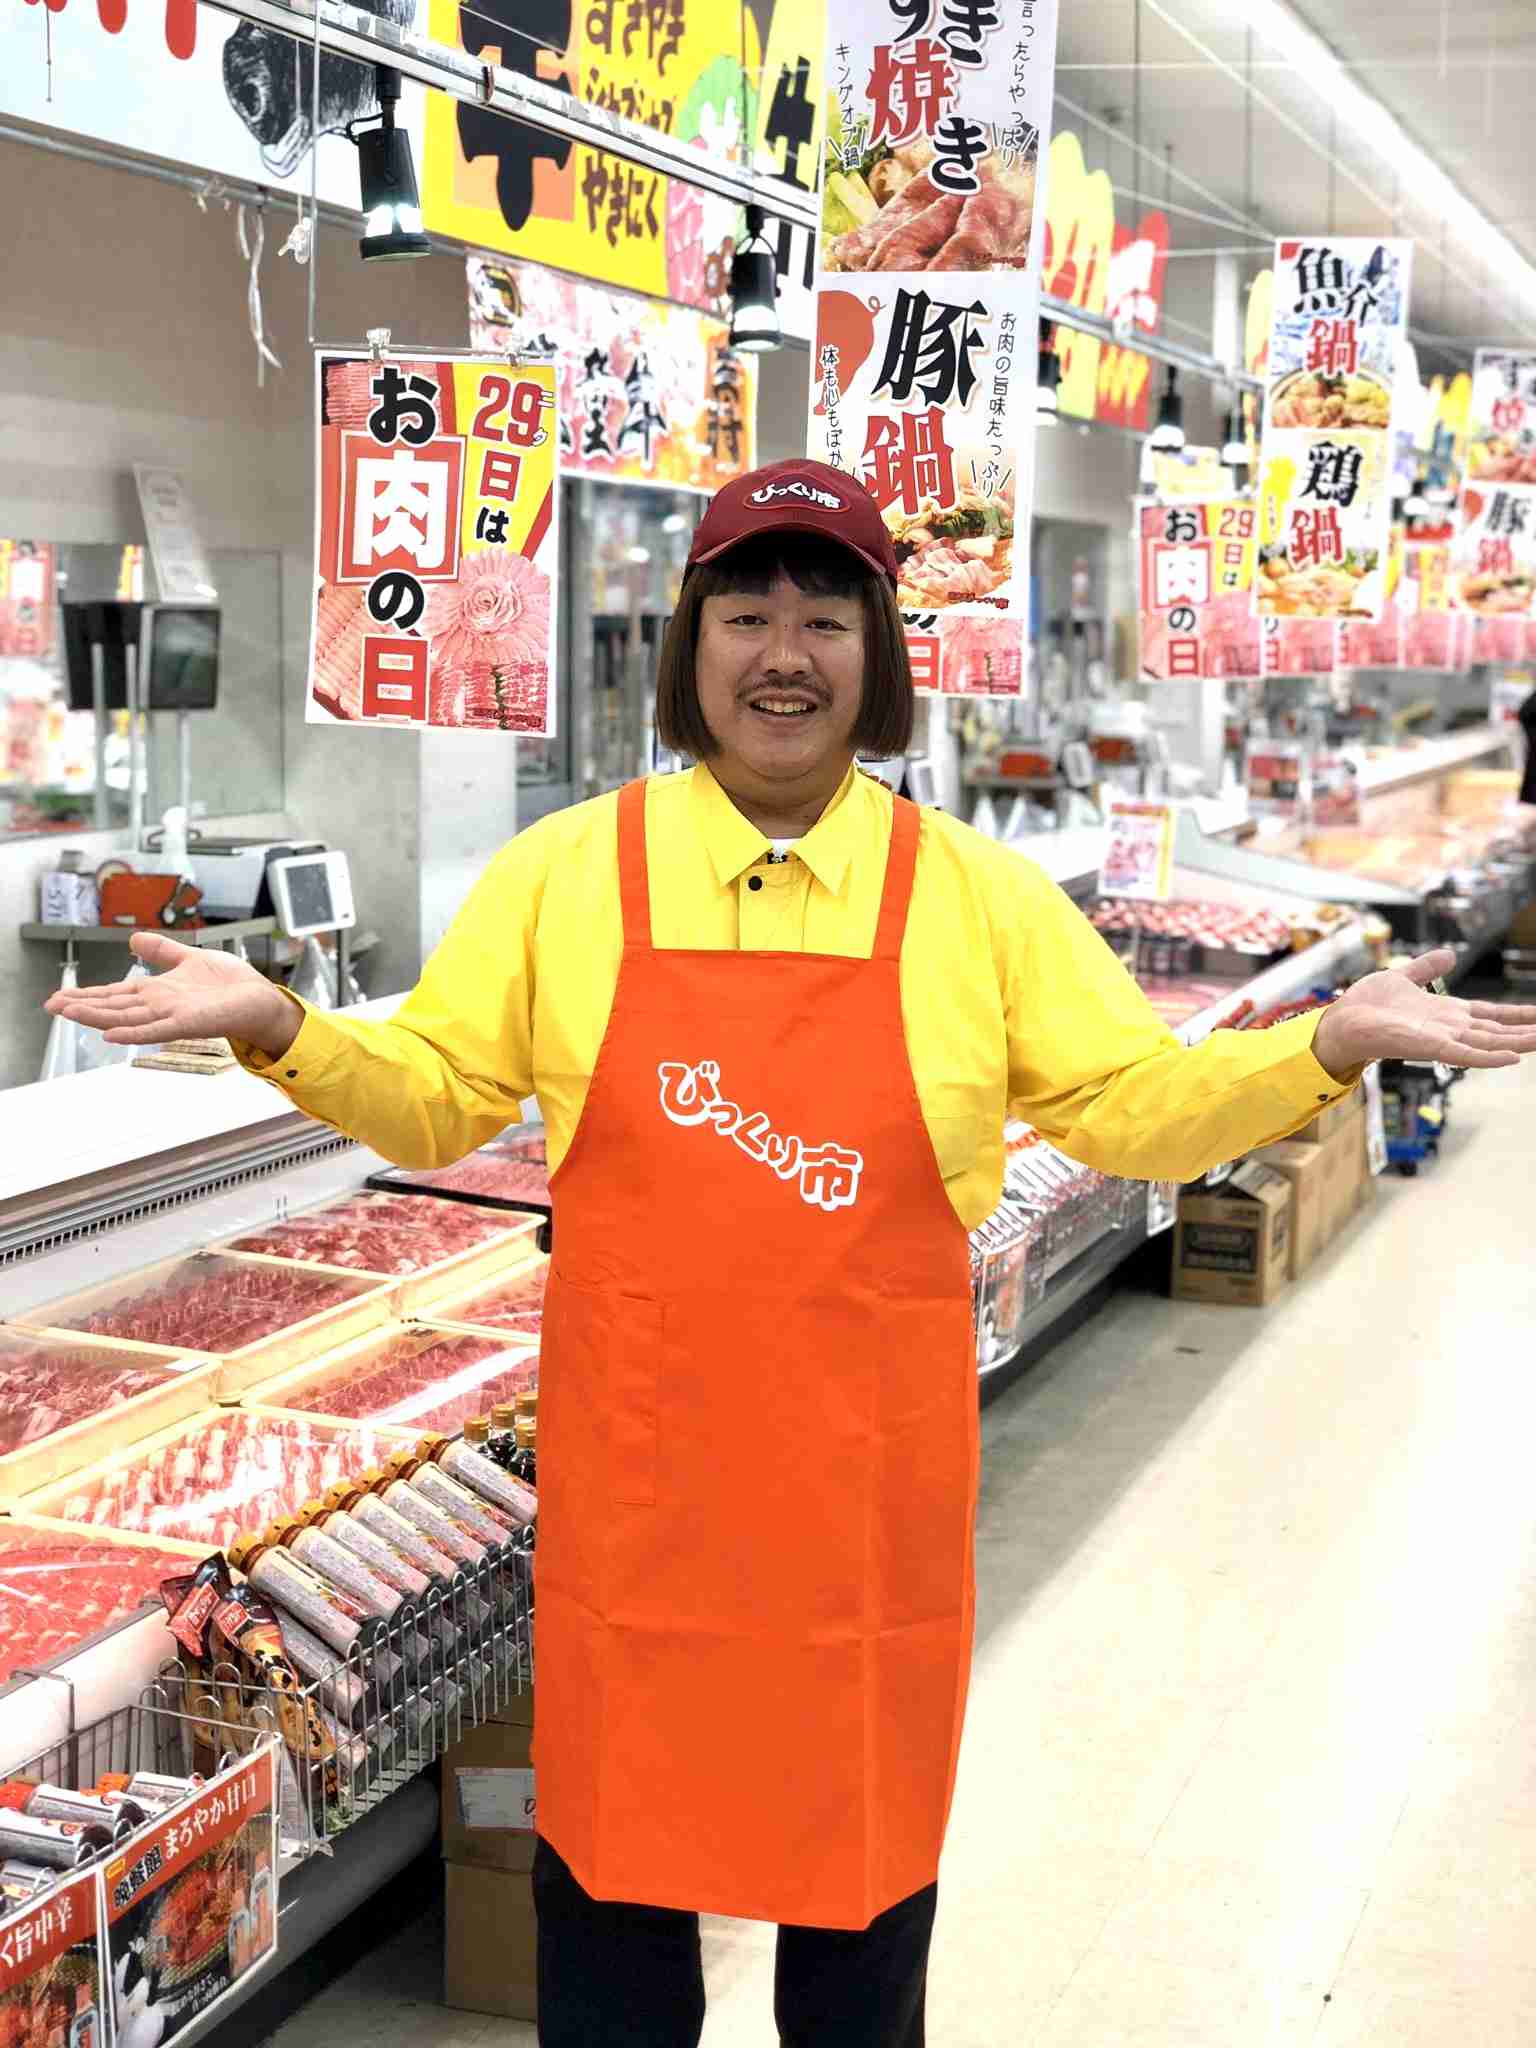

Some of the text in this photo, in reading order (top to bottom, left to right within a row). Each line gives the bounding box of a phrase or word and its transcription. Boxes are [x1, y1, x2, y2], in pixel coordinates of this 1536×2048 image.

[581, 150, 659, 248] やきにく
[1294, 247, 1379, 375] 魚介鍋
[472, 375, 544, 544] 29日は
[862, 287, 988, 516] 豚鍋
[981, 312, 1017, 498] お肉の旨味たっぷり
[351, 366, 441, 723] お肉の日
[1290, 440, 1364, 566] 鶏鍋
[657, 1060, 864, 1212] びっくり市
[165, 1772, 257, 1861] まろやか甘口
